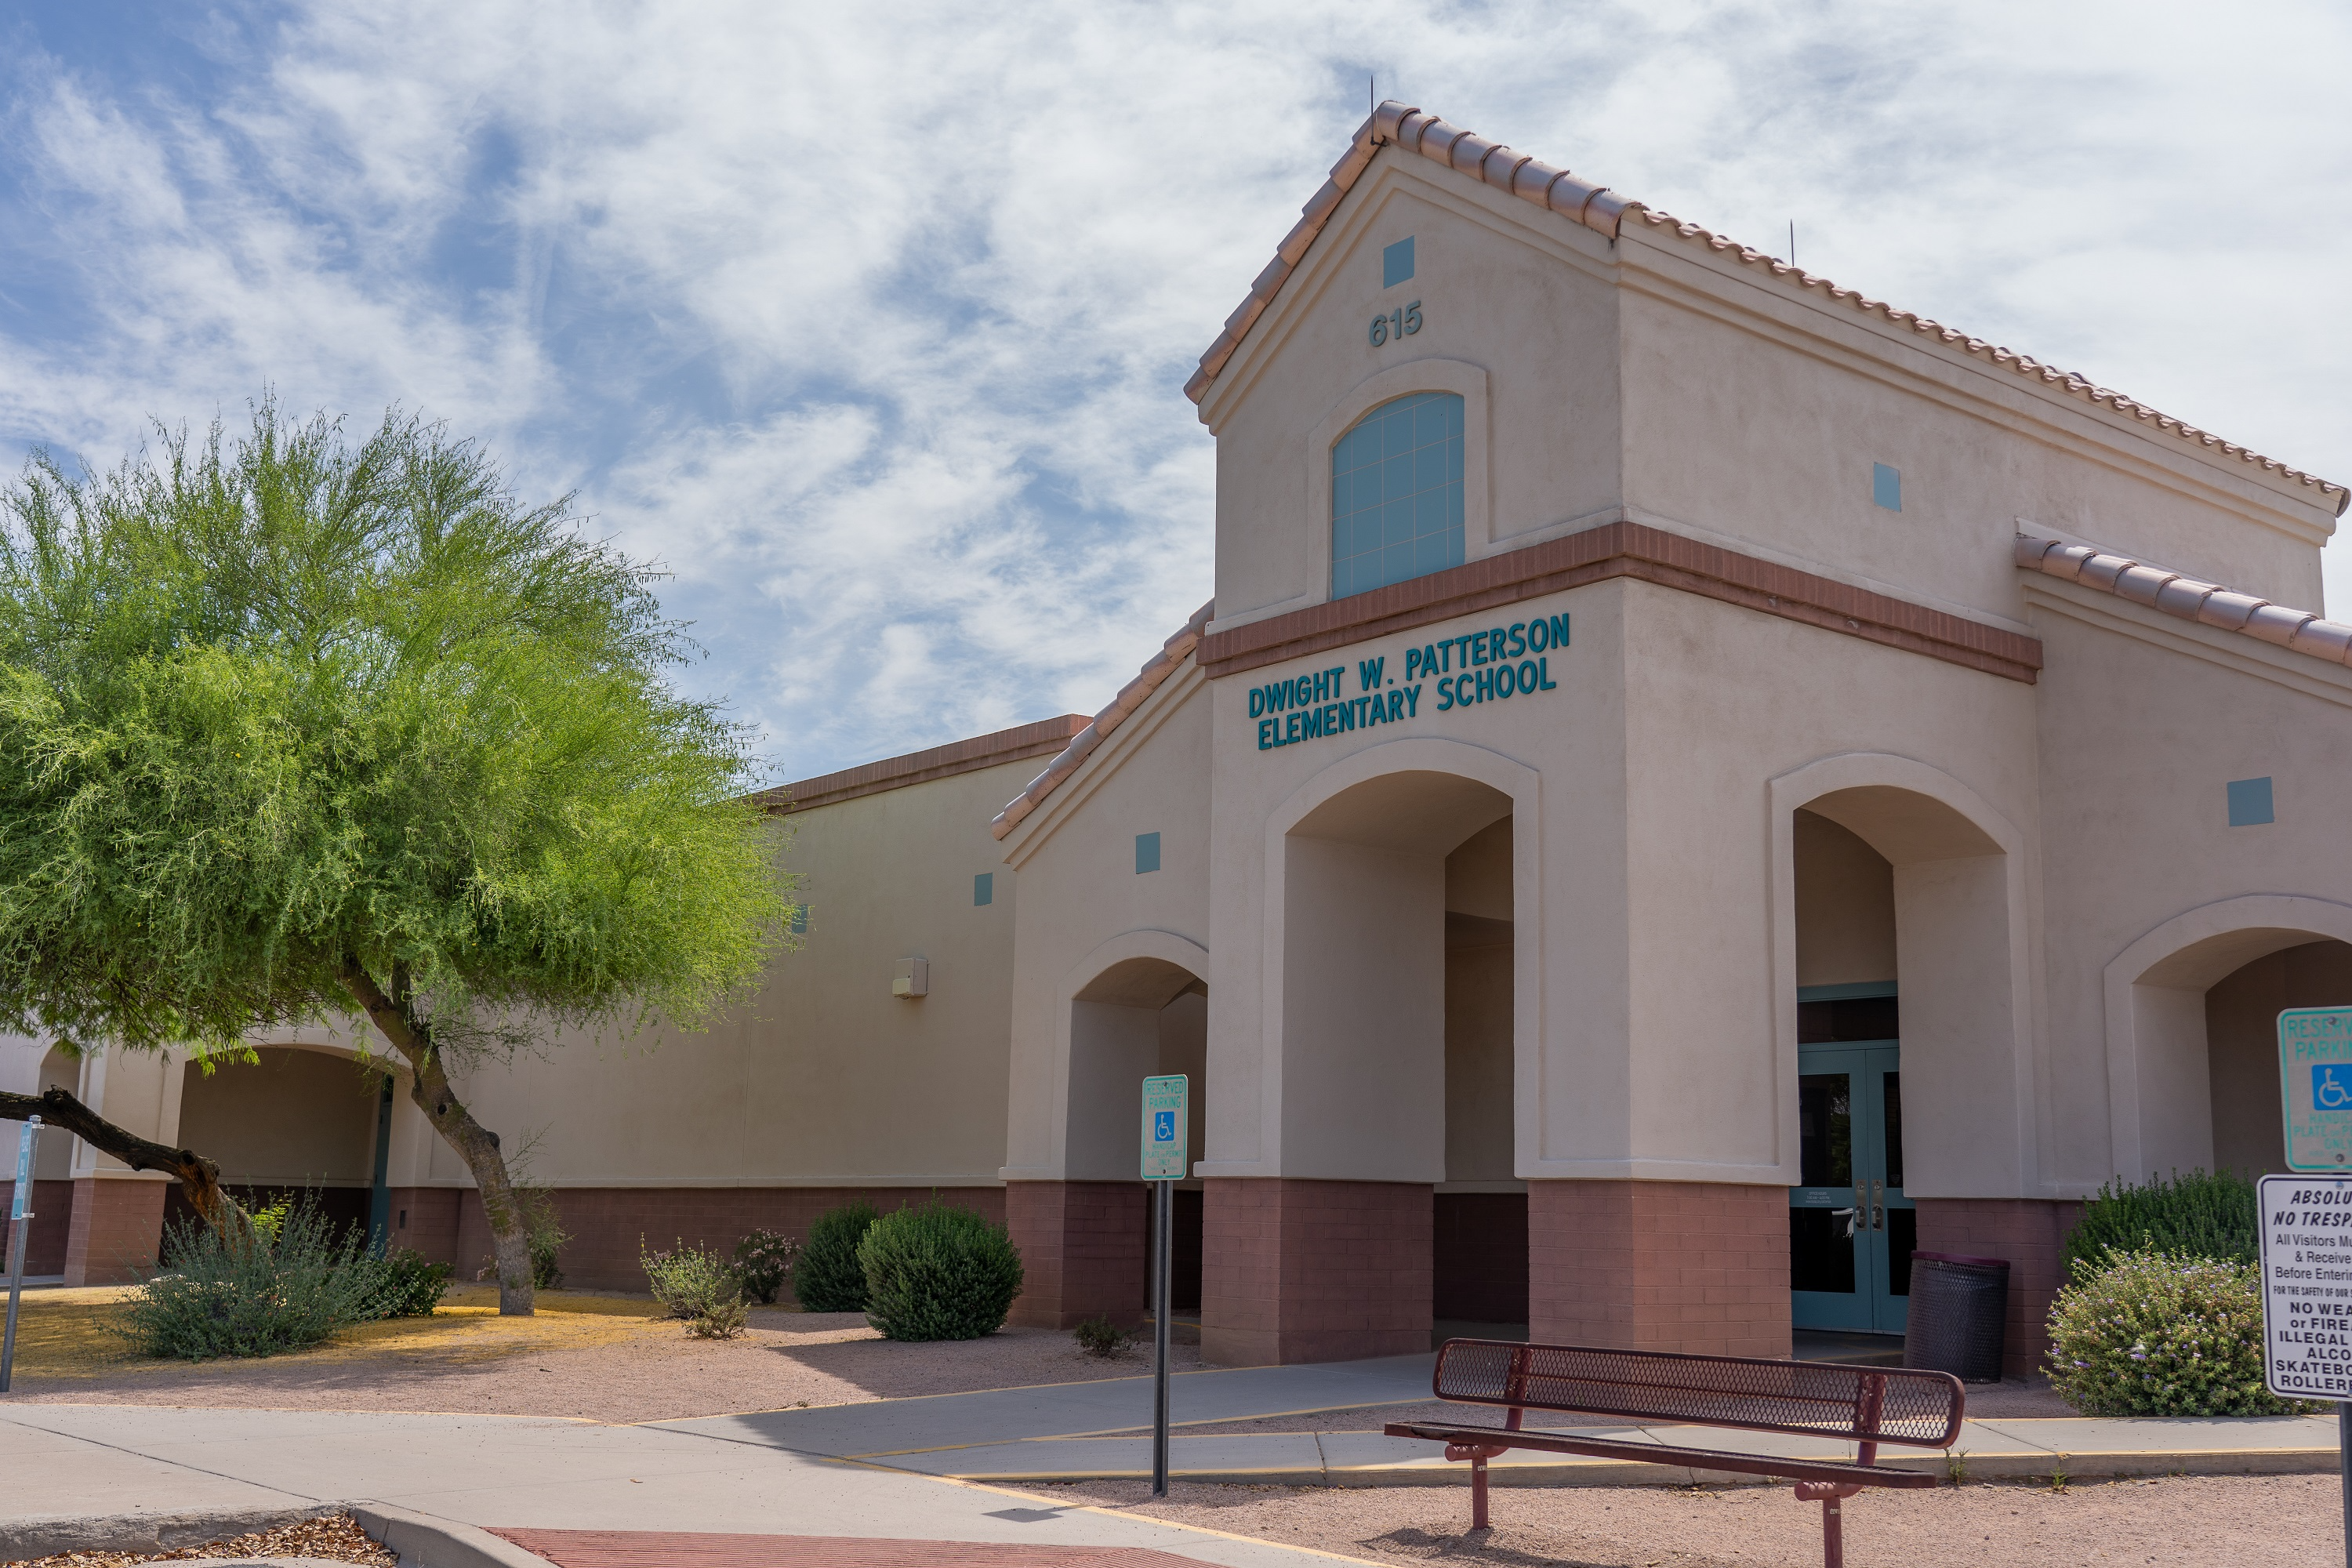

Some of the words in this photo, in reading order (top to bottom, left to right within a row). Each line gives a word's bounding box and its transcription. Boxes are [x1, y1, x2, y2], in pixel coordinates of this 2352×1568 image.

[1368, 299, 1423, 347] 615
[1248, 666, 1345, 718] DWIGHT
[1359, 656, 1394, 691] W.
[1406, 612, 1570, 681] PATTERSON
[1258, 684, 1422, 750] ELEMENTARY
[1436, 657, 1556, 711] SCHOOL
[1146, 1081, 1183, 1094] RESERVED
[1149, 1095, 1181, 1109] PARKING
[2293, 1124, 2328, 1138] PLATE
[1166, 1149, 1183, 1158] PERMIT
[1158, 1158, 1171, 1167] ONLY
[2290, 1190, 2352, 1205] ABSOLU
[2273, 1210, 2296, 1225] NO
[2302, 1211, 2352, 1227] TRESP
[2275, 1233, 2290, 1245] All
[2292, 1233, 2336, 1247] Visitors
[2295, 1250, 2303, 1262] &
[2307, 1250, 2351, 1264] Receive
[2275, 1266, 2312, 1279] Before
[2273, 1285, 2286, 1294] FOR
[2287, 1286, 2299, 1295] THE
[2301, 1287, 2324, 1297] SAFETY
[2325, 1288, 2334, 1297] OF
[2336, 1288, 2349, 1298] OUR
[2290, 1301, 2313, 1314] NO
[2290, 1319, 2307, 1328] or
[2310, 1317, 2352, 1331] FIRE
[2279, 1330, 2349, 1346] ILLEGAL
[2307, 1347, 2352, 1361] ALCO
